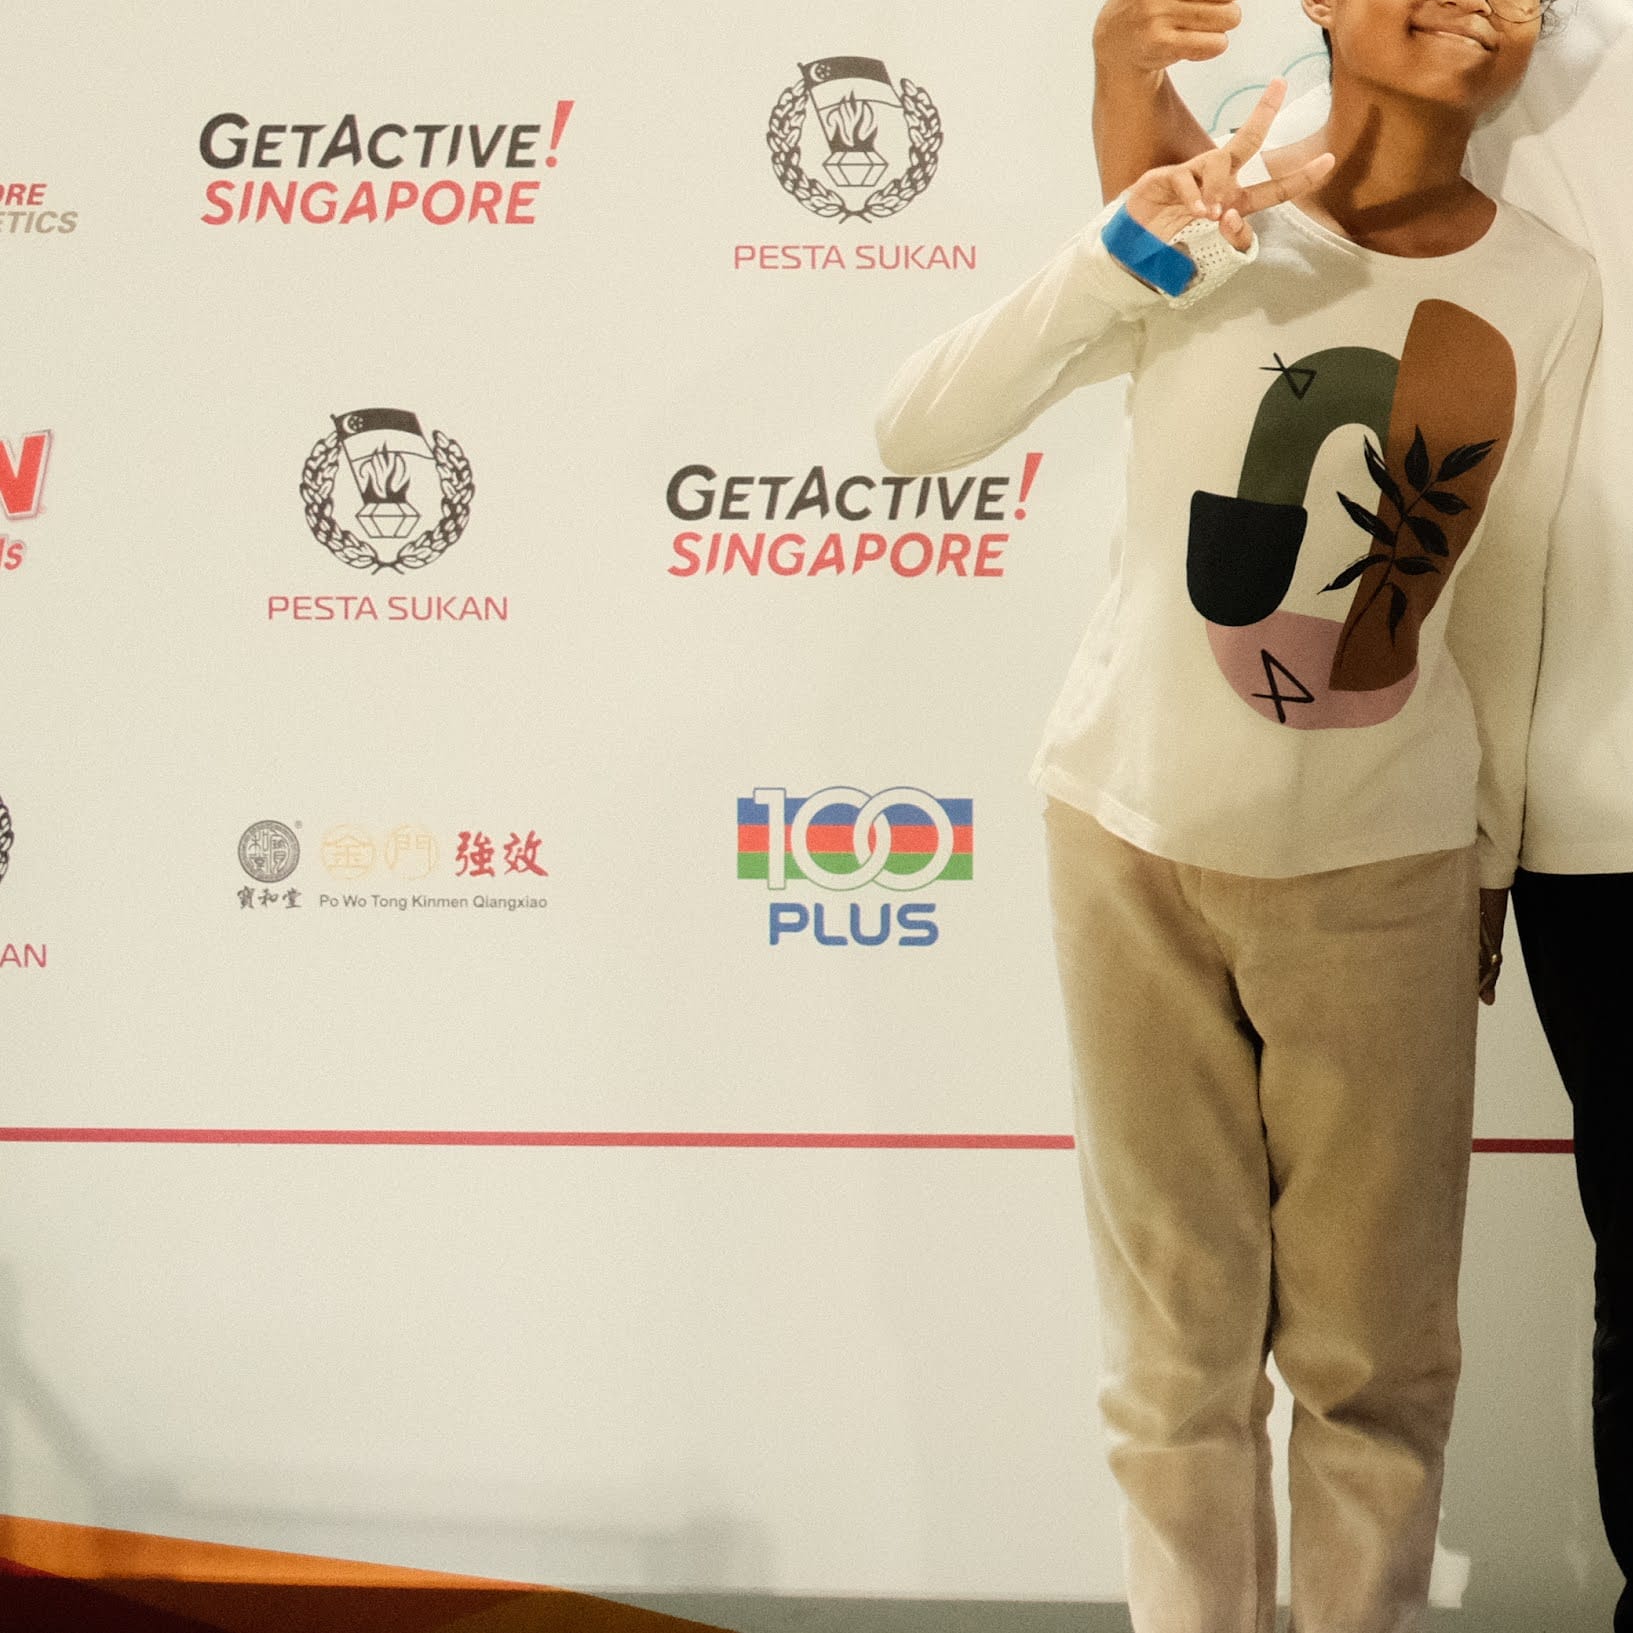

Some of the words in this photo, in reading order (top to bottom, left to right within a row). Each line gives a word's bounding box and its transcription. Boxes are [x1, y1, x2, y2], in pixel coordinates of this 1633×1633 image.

[200, 179, 542, 226] SINGAPORE
[734, 244, 846, 270] PESTA
[856, 244, 977, 270] SUKAN
[667, 531, 1010, 579] SINGAPORE
[268, 596, 379, 621] PESTA
[387, 596, 508, 622] SUKAN
[753, 785, 954, 891] 100
[320, 894, 339, 908] Po
[344, 894, 367, 908] Wo
[372, 894, 407, 911] Tong
[412, 894, 468, 908] Kinmen
[473, 894, 548, 911] Qiangxiao
[769, 903, 940, 947] PLUS
